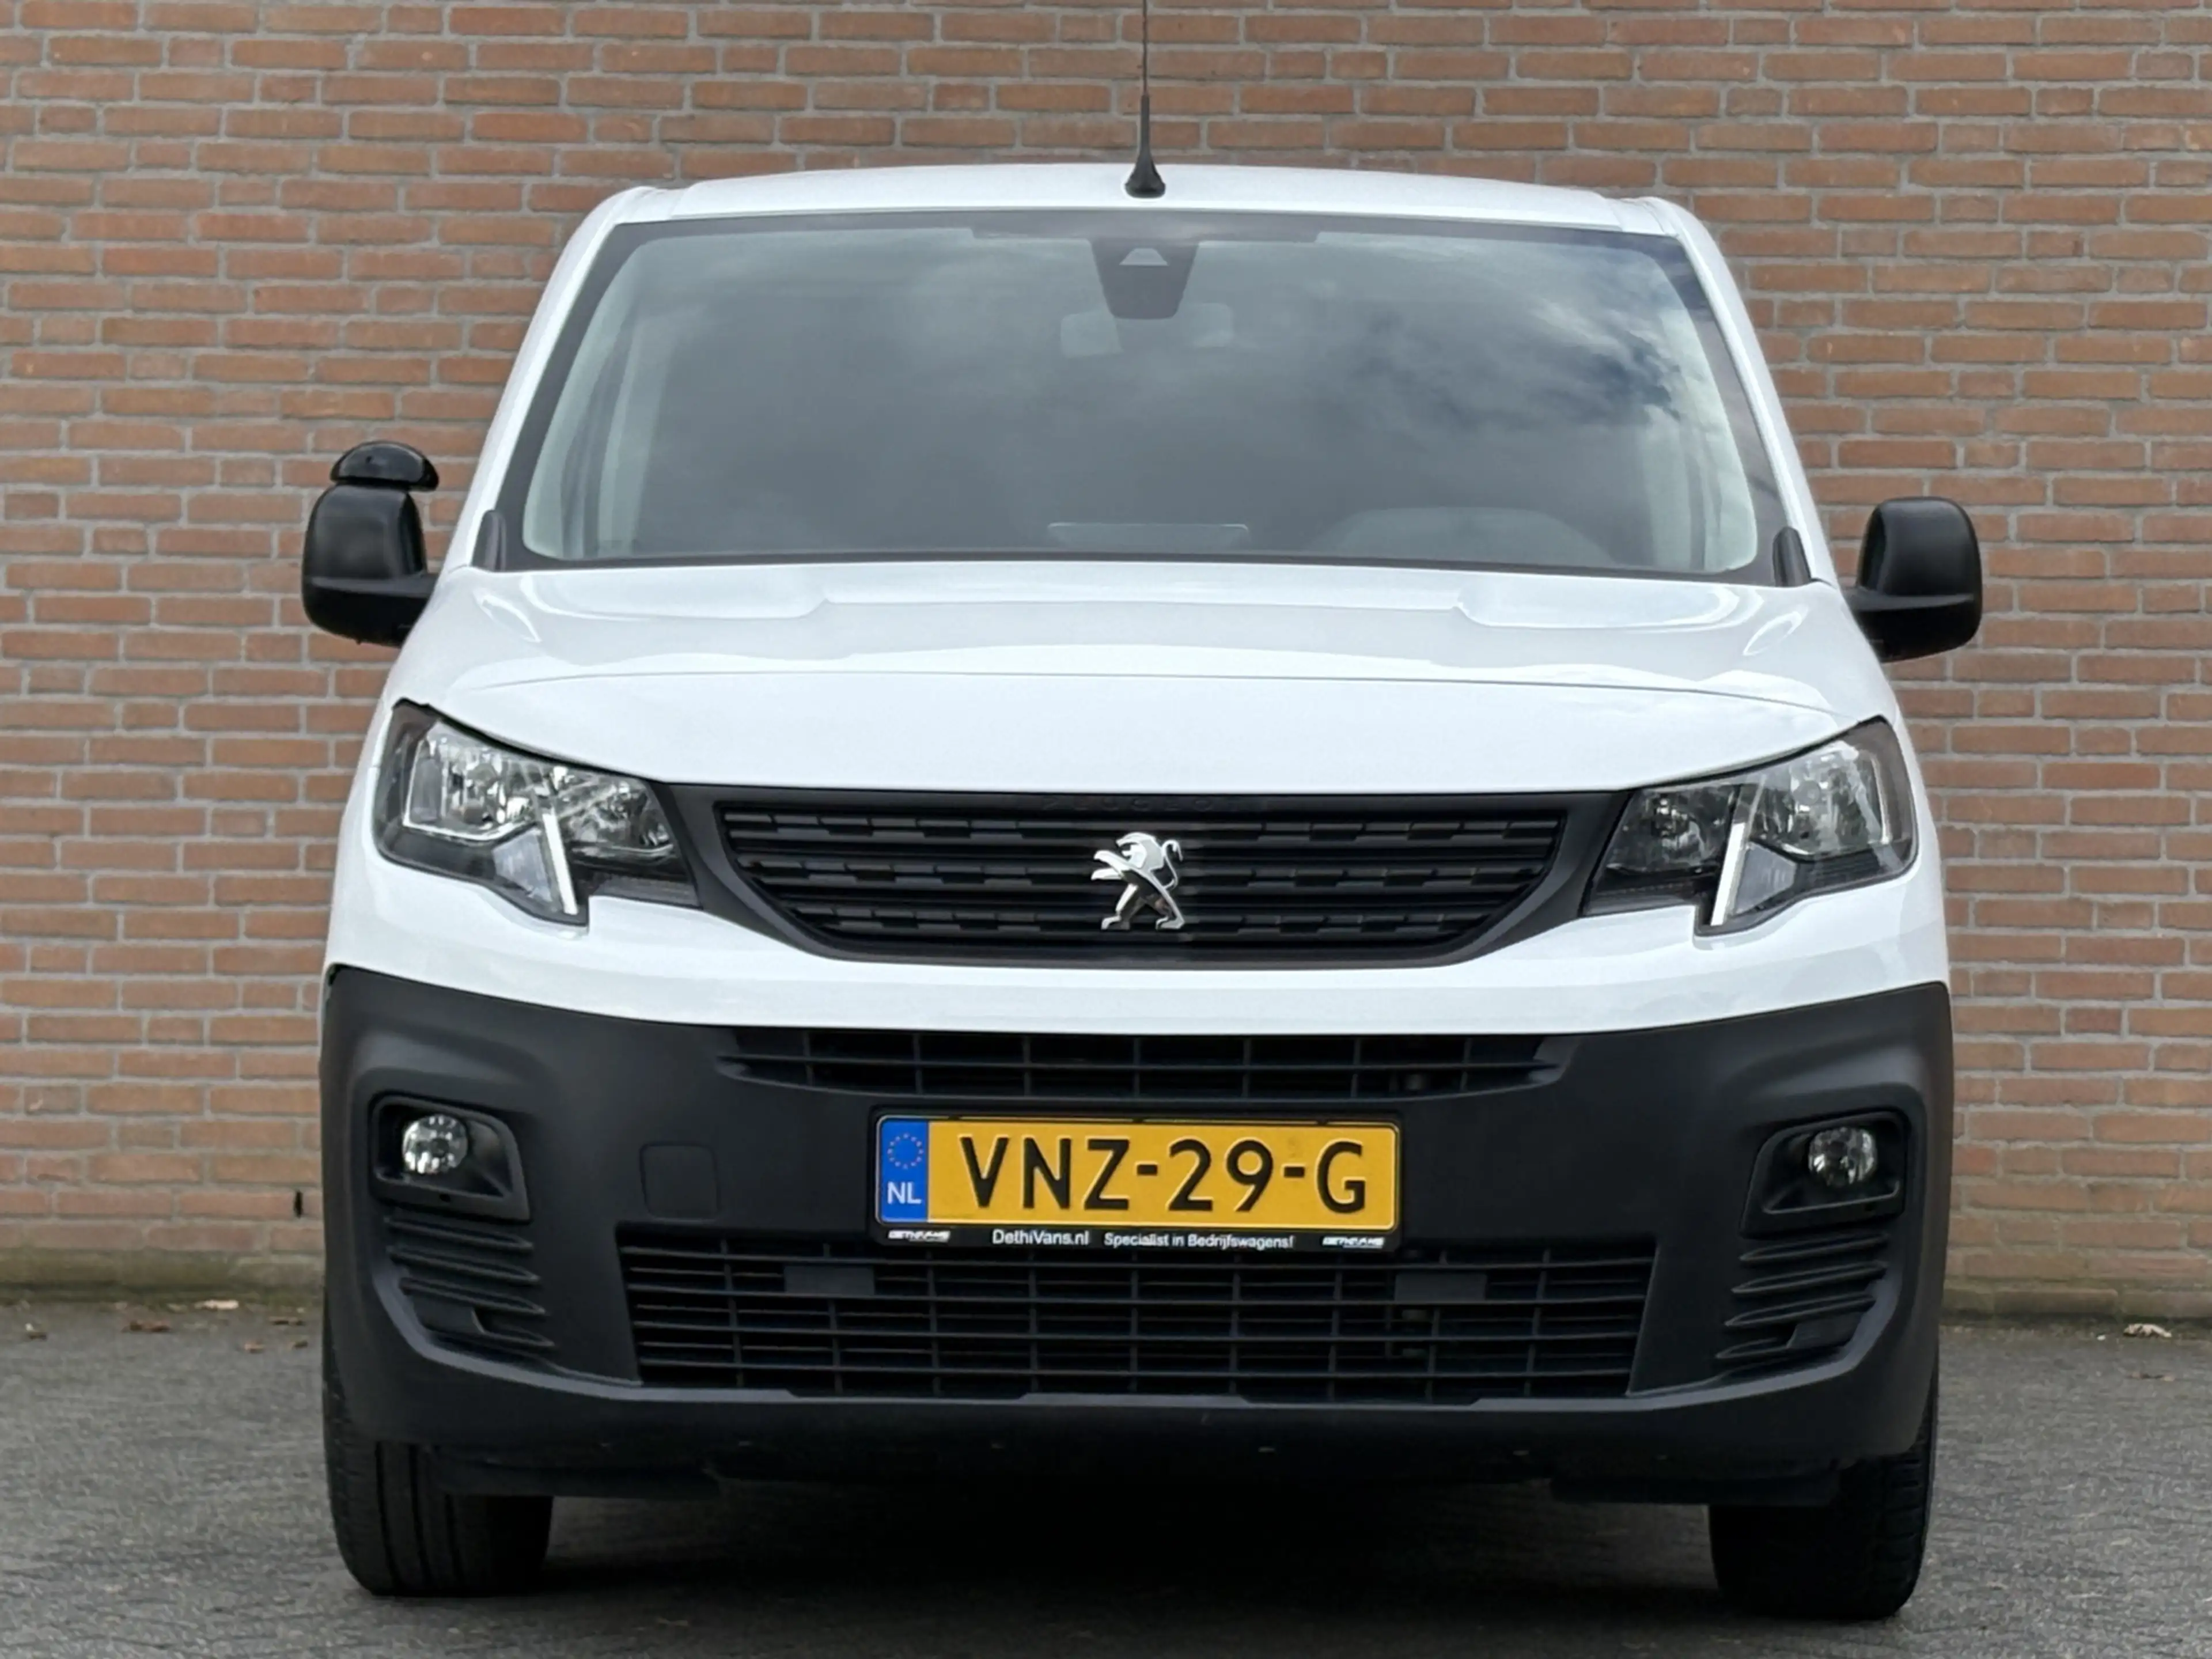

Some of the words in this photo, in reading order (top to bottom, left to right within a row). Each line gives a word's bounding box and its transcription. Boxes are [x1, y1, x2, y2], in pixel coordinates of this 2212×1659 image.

[959, 1137, 1366, 1214] VNZ-29-G
[887, 1181, 922, 1204] NL
[1104, 1232, 1169, 1248] Specialist
[1172, 1233, 1184, 1246] in
